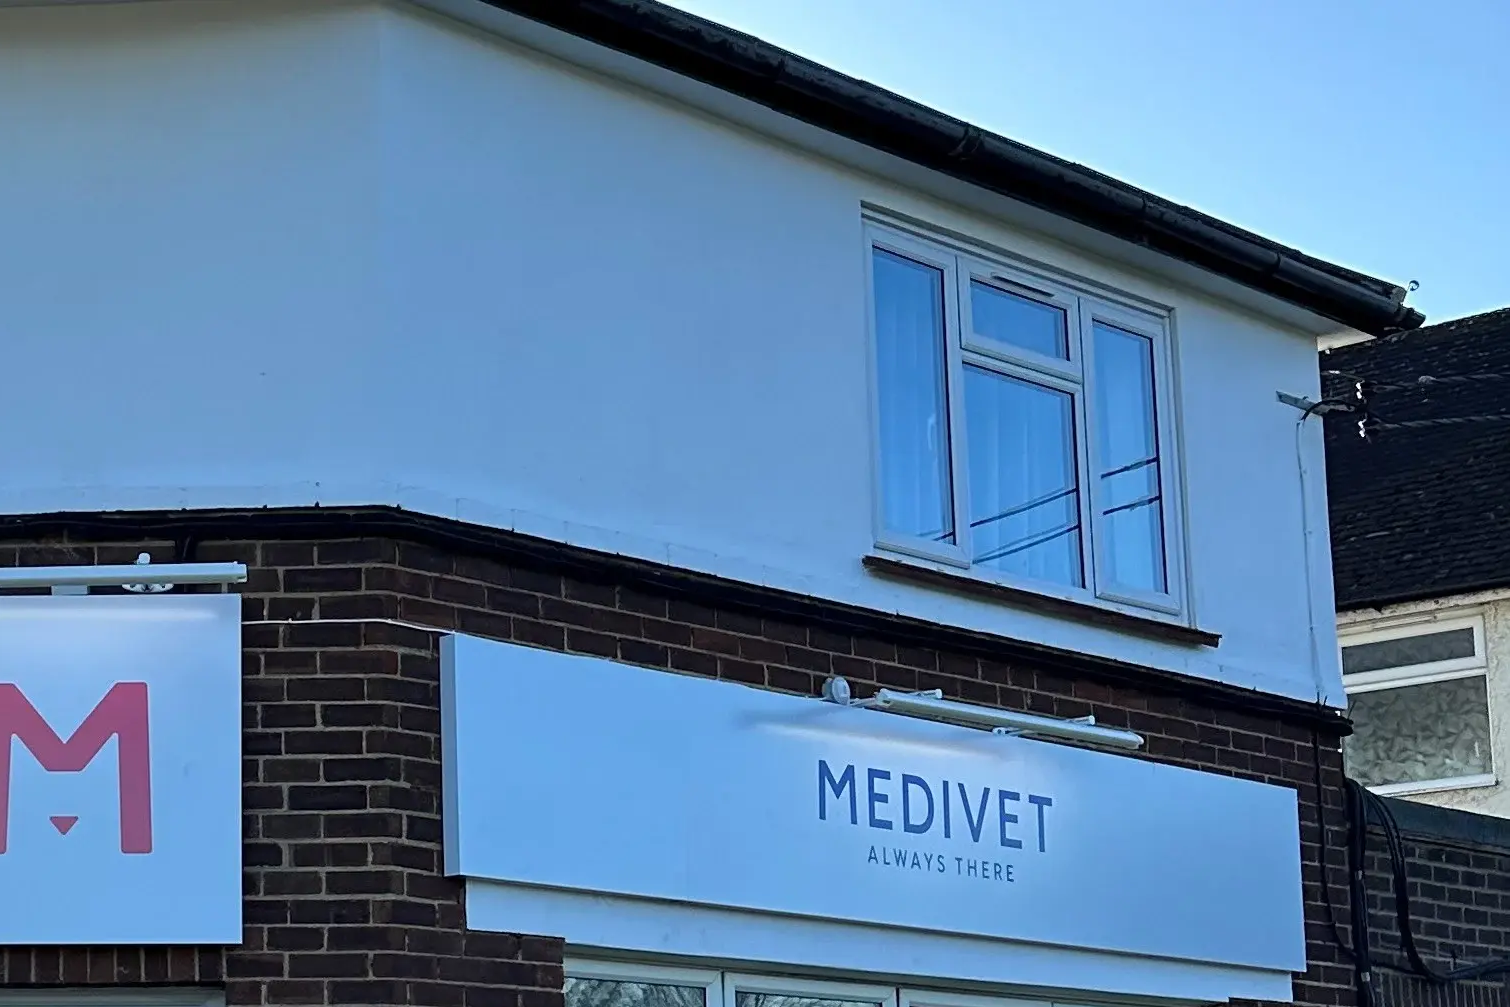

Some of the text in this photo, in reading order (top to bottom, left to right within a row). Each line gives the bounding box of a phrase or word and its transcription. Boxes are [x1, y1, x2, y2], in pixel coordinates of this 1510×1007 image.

[818, 759, 1052, 853] MEDIVET
[867, 845, 1015, 883] ALWAYS THERE
